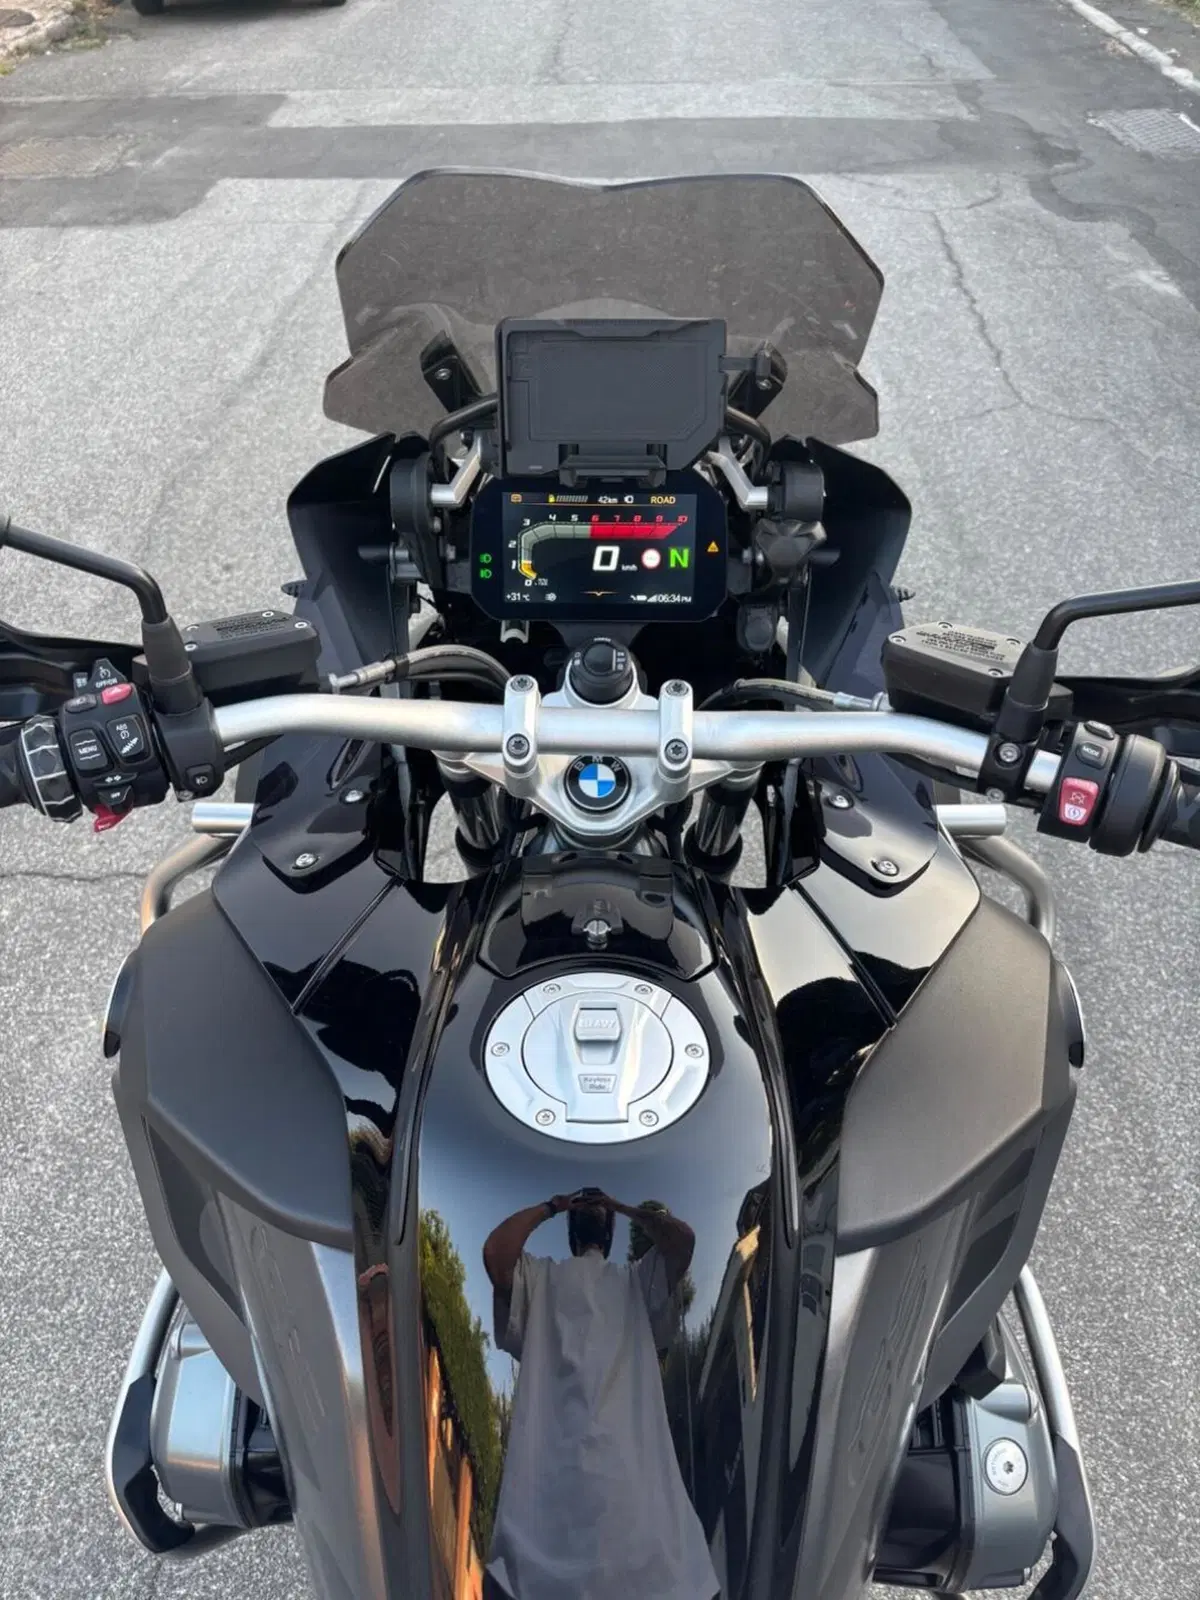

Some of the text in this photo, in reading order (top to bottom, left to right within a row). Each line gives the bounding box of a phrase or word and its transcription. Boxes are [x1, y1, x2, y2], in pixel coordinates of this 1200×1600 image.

[650, 496, 677, 504] ROAD
[548, 513, 557, 521] 4
[571, 514, 579, 522] 5
[591, 514, 600, 522] 6
[633, 514, 642, 522] 8
[655, 514, 664, 522] 9
[522, 518, 531, 526] 3
[508, 540, 517, 548] 2
[592, 545, 620, 571] 0
[669, 547, 689, 568] N
[511, 560, 517, 570] 1
[78, 744, 98, 755] MENU
[573, 755, 623, 772] BMW
